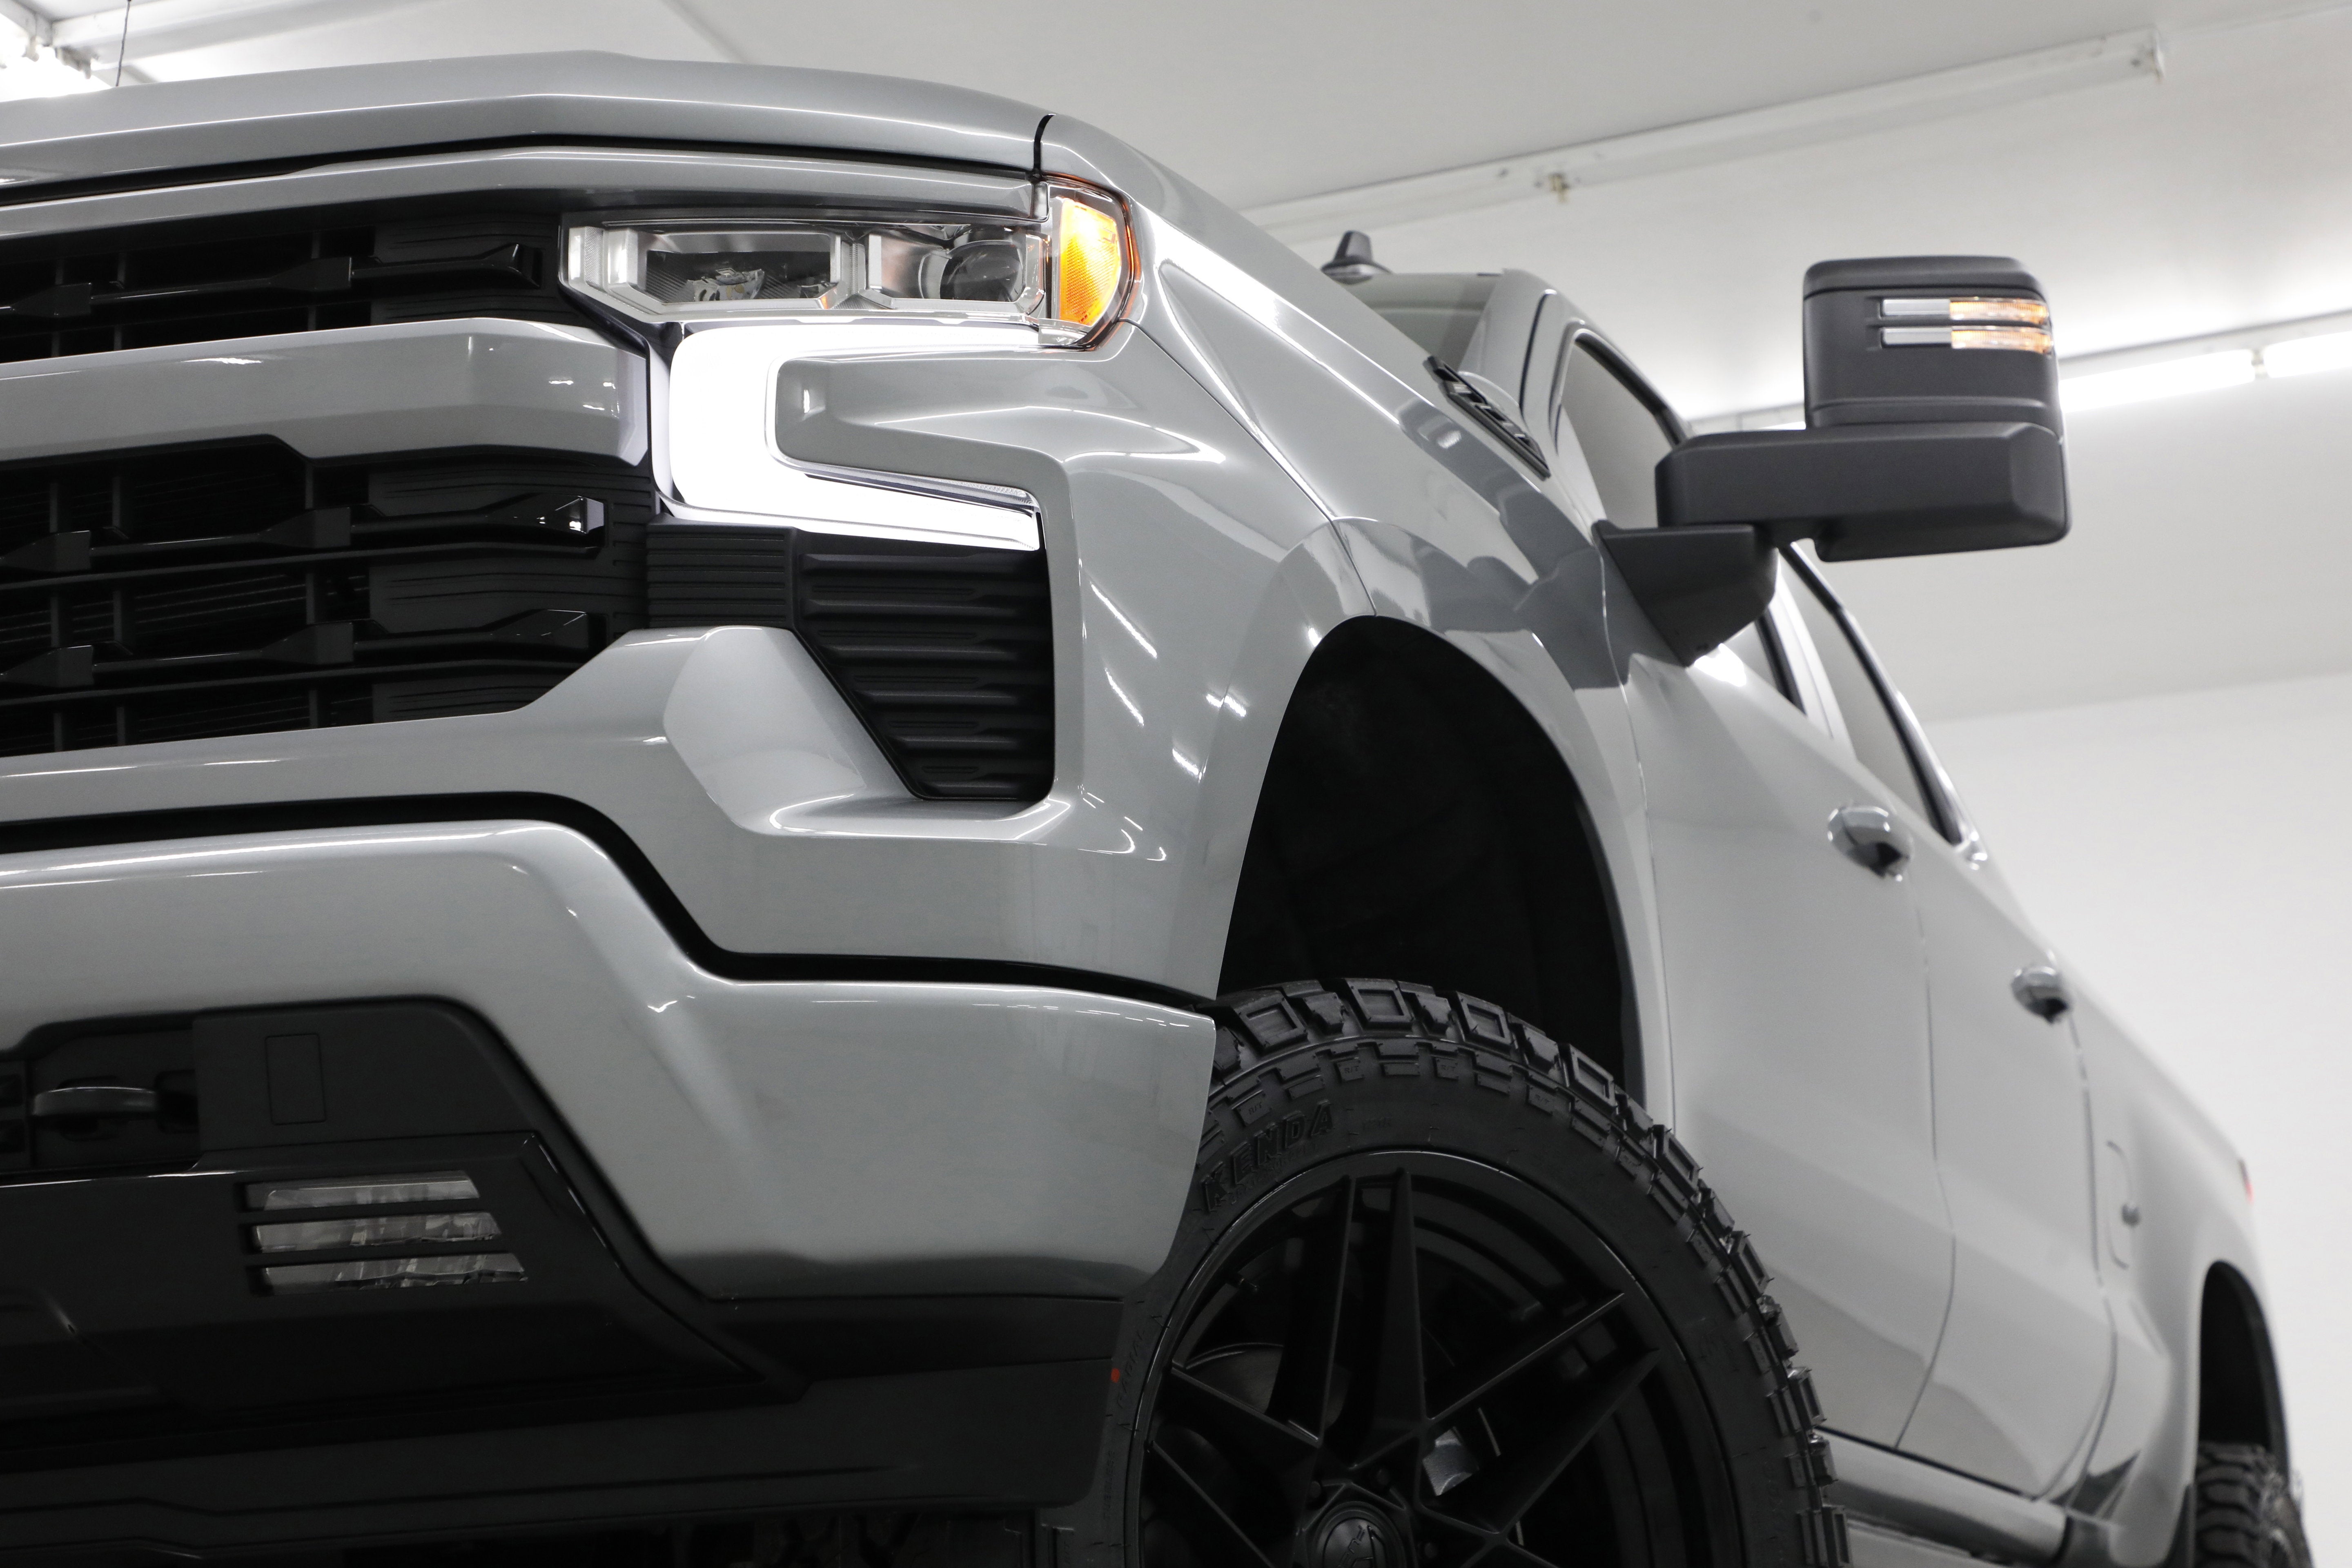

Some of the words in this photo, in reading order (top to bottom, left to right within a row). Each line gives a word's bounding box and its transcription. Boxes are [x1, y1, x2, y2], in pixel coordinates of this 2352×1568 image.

[1344, 1065, 1360, 1074] R/T
[1247, 1101, 1263, 1115] R/T
[1202, 1099, 1334, 1212] KENDA
[1116, 1330, 1145, 1410] RADIAL
[1103, 1450, 1116, 1520] TUBELESS
[1337, 1525, 1365, 1568] FUE
